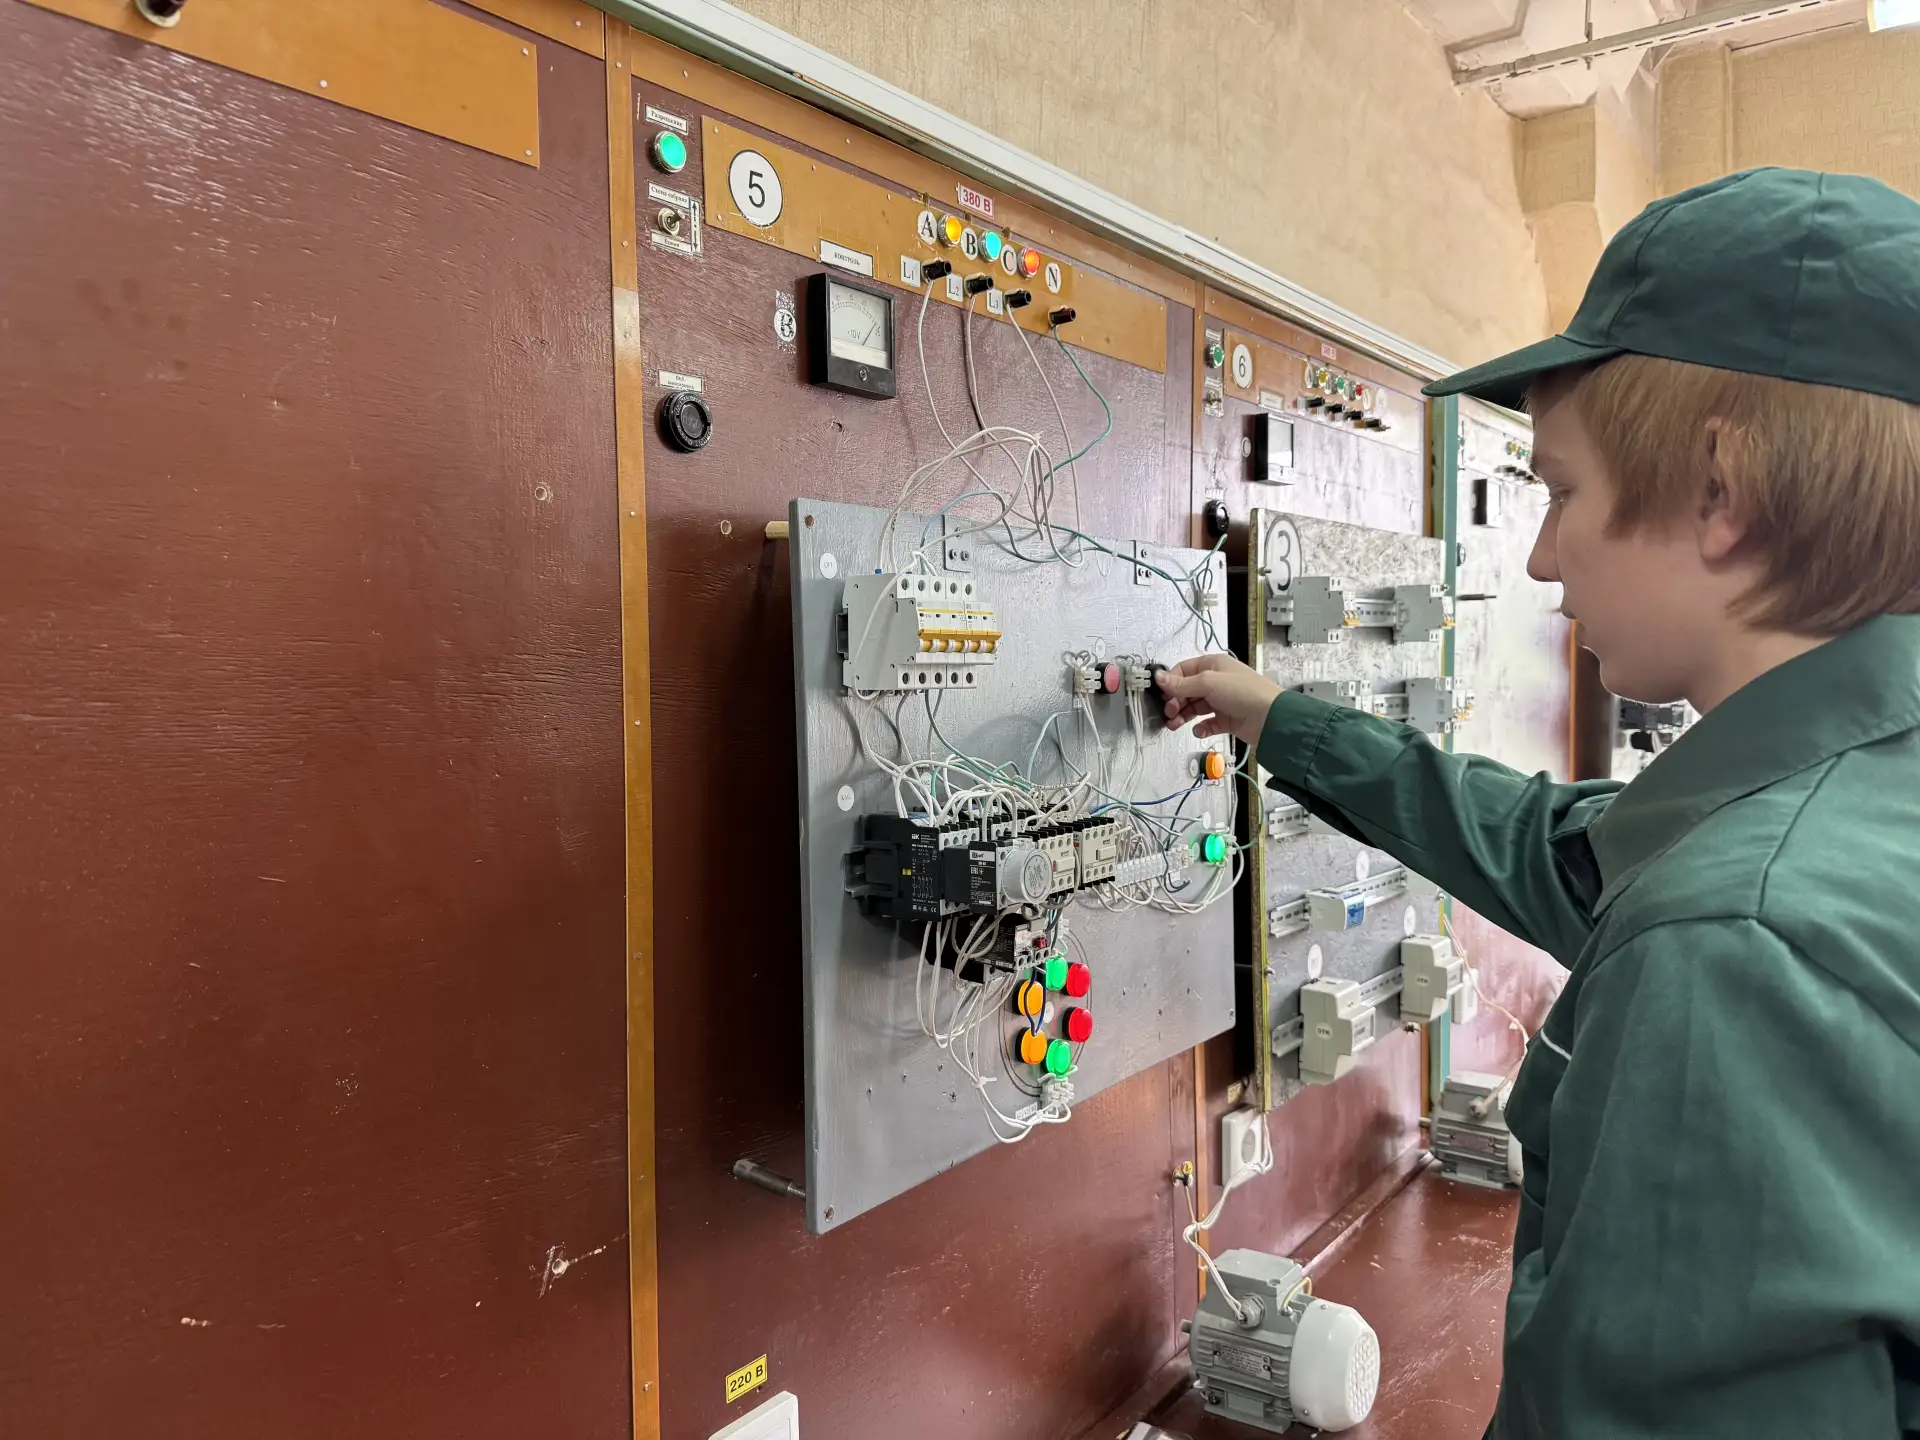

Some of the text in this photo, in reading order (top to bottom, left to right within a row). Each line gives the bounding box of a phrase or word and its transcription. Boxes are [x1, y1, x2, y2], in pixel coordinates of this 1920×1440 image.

[748, 170, 766, 208] 5
[963, 189, 980, 209] 380
[921, 213, 934, 238] A
[966, 231, 976, 256] B
[834, 252, 860, 266] КОНТРОЛЬ
[1002, 250, 1014, 272] C
[1048, 266, 1058, 289] N
[1238, 355, 1246, 378] 6
[1278, 530, 1291, 591] 3
[730, 1371, 752, 1392] 220
